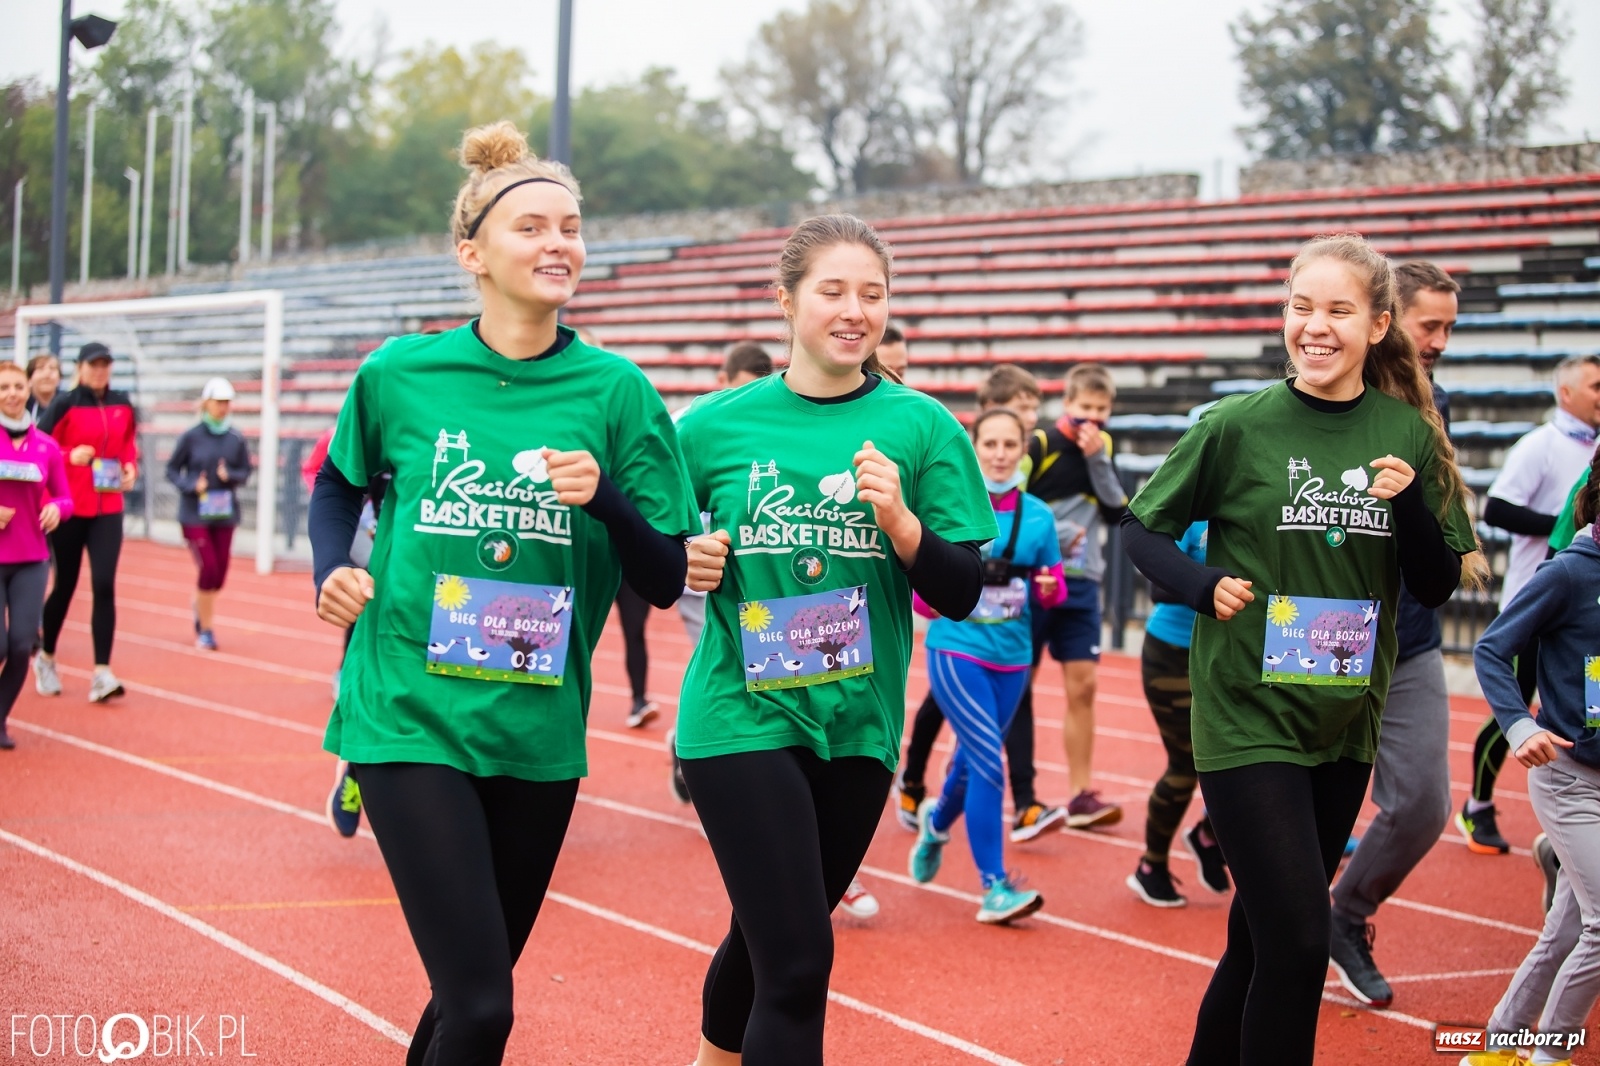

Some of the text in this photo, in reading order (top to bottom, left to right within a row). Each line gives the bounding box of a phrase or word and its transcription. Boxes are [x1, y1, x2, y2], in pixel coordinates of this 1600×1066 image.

[1282, 505, 1389, 530] BASKETBALL
[739, 523, 882, 550] BASKETBALL
[449, 611, 477, 626] BIEG
[483, 615, 507, 629] DLA
[759, 618, 860, 643] BIEG DLA BOŻENY
[1282, 627, 1370, 641] BIEG DLA BOŻENY
[510, 650, 553, 671] 032
[822, 648, 860, 669] 041
[1329, 658, 1363, 674] 055
